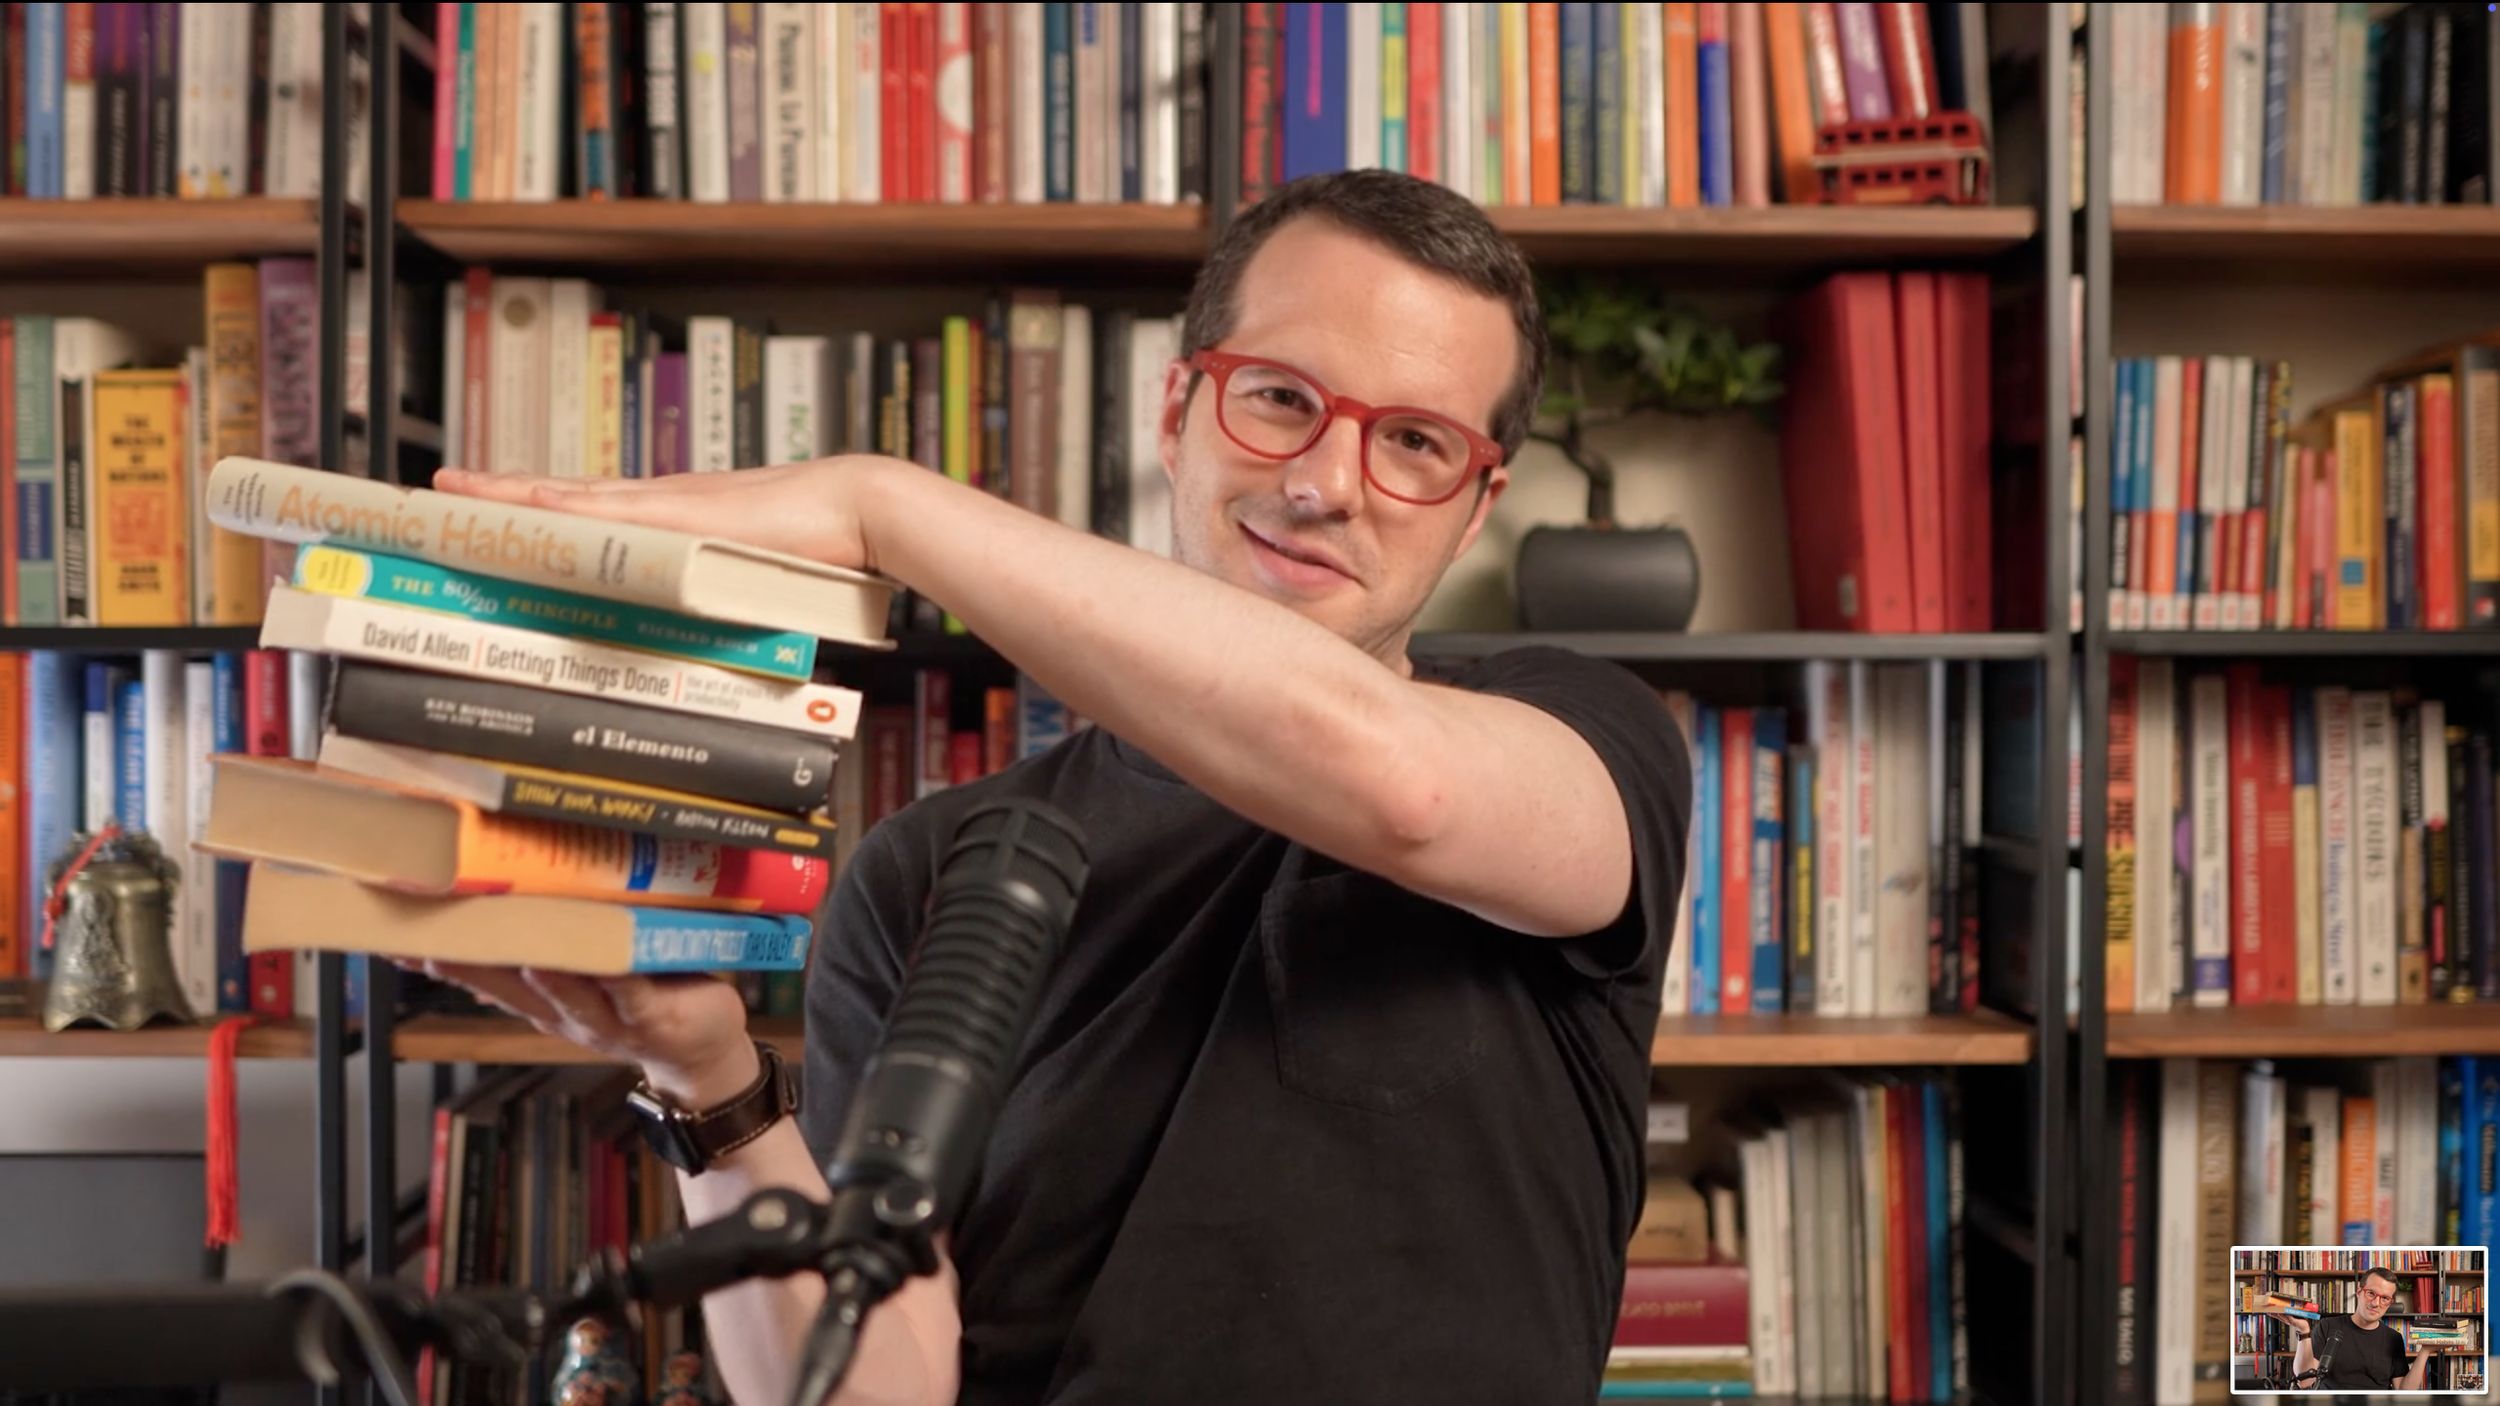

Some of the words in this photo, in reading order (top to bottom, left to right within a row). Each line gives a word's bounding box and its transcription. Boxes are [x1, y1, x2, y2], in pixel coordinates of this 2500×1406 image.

[275, 485, 426, 550] Atomic
[440, 511, 579, 577] Habits
[391, 574, 435, 597] THE
[441, 578, 499, 616] 80/20
[506, 596, 619, 631] PRINCIPLE
[363, 621, 417, 654] David
[421, 634, 471, 663] Allen
[637, 621, 709, 646] RICHARD
[713, 636, 760, 655] KOCH
[485, 643, 553, 683] Getting
[558, 653, 620, 691] Things
[623, 666, 671, 697] Done
[459, 702, 536, 725] ROBINSON
[572, 726, 596, 747] el
[602, 729, 710, 764] Elemento
